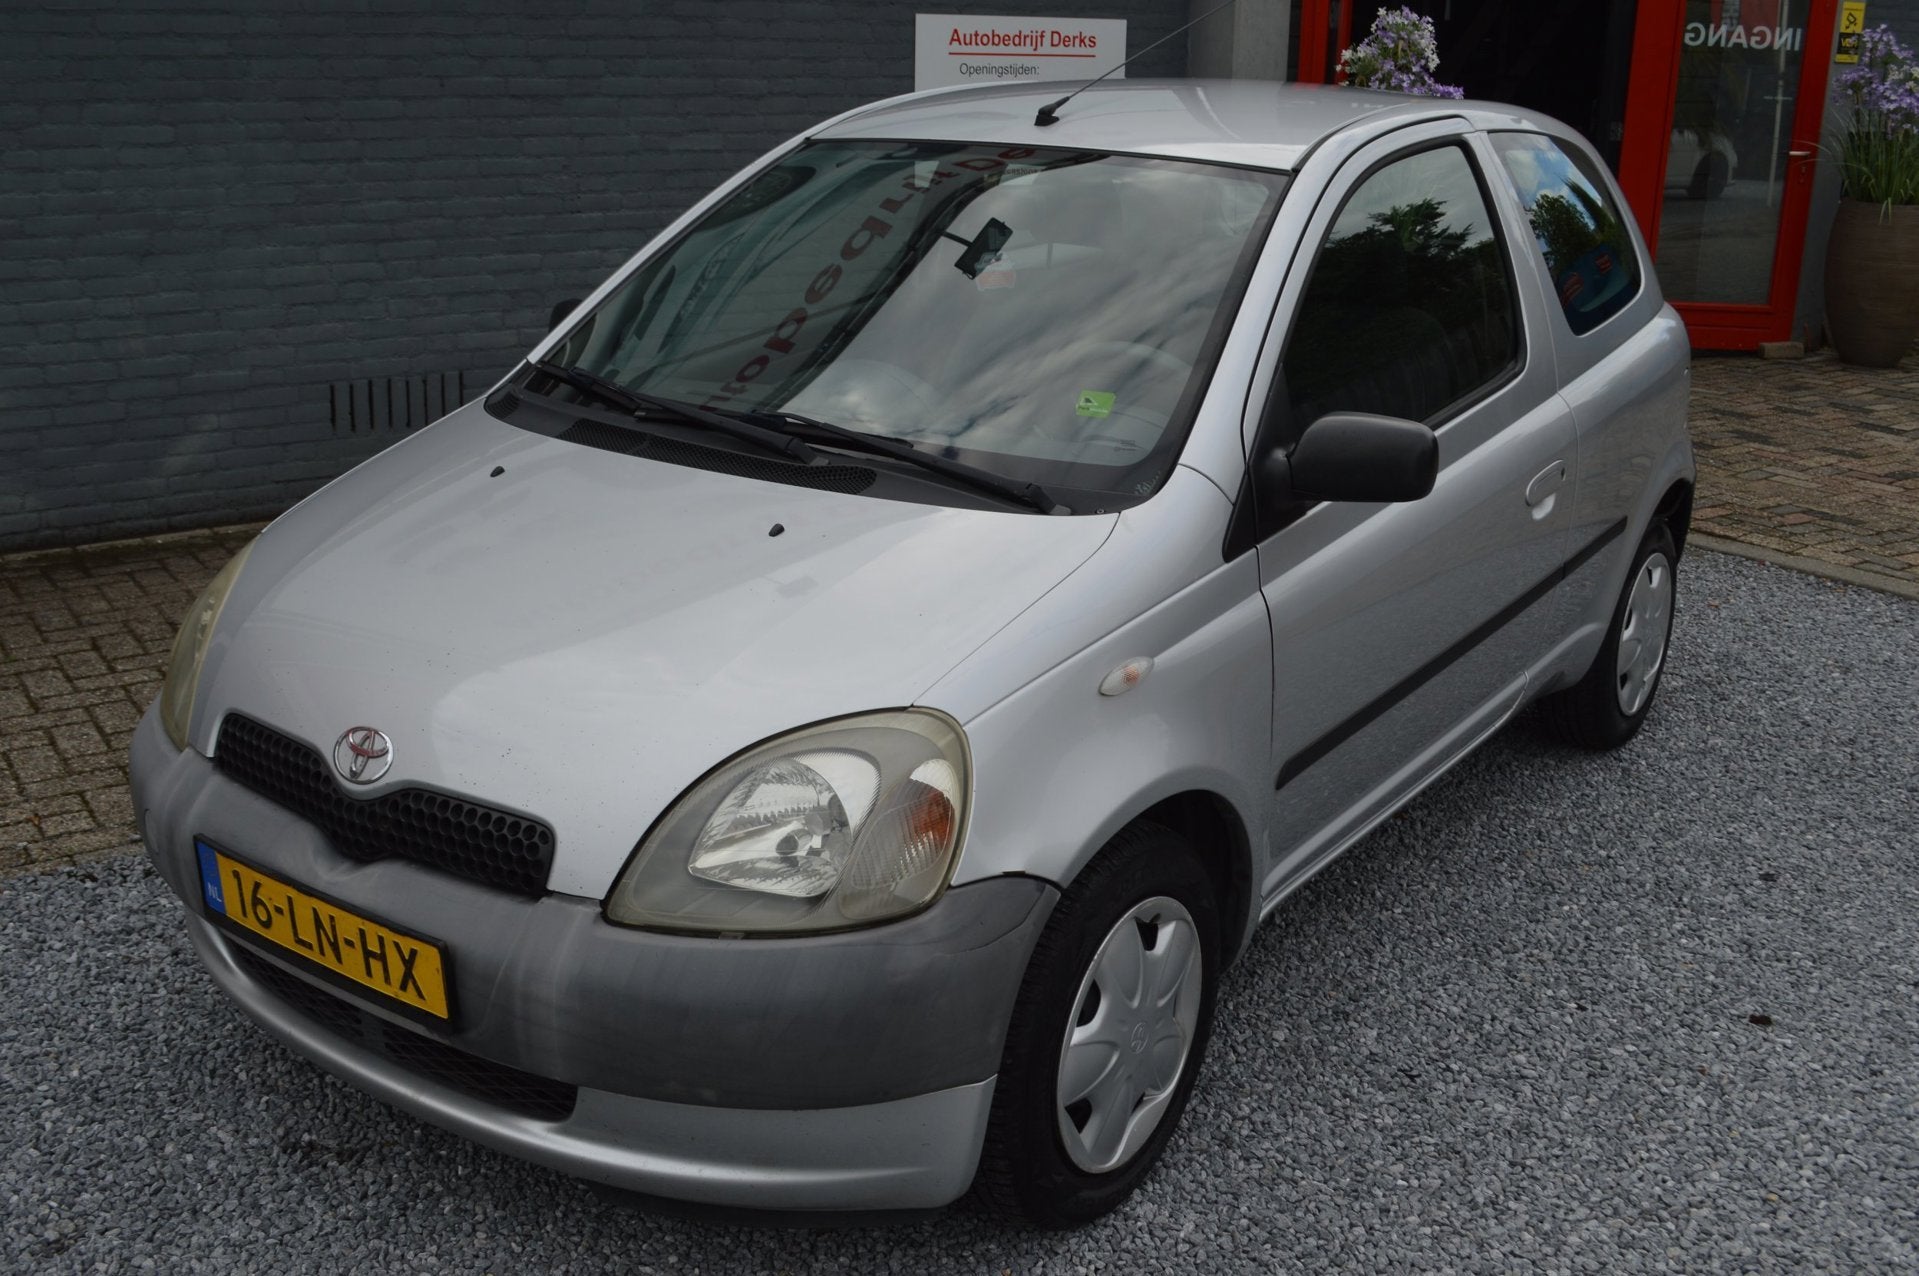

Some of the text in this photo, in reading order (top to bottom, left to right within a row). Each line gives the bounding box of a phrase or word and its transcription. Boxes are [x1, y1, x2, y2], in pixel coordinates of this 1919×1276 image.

[949, 28, 1097, 51] Autobedrijf Derks
[959, 63, 1040, 78] Openingstijden:
[207, 882, 222, 903] NL
[231, 869, 426, 1002] 16-LN-HX
